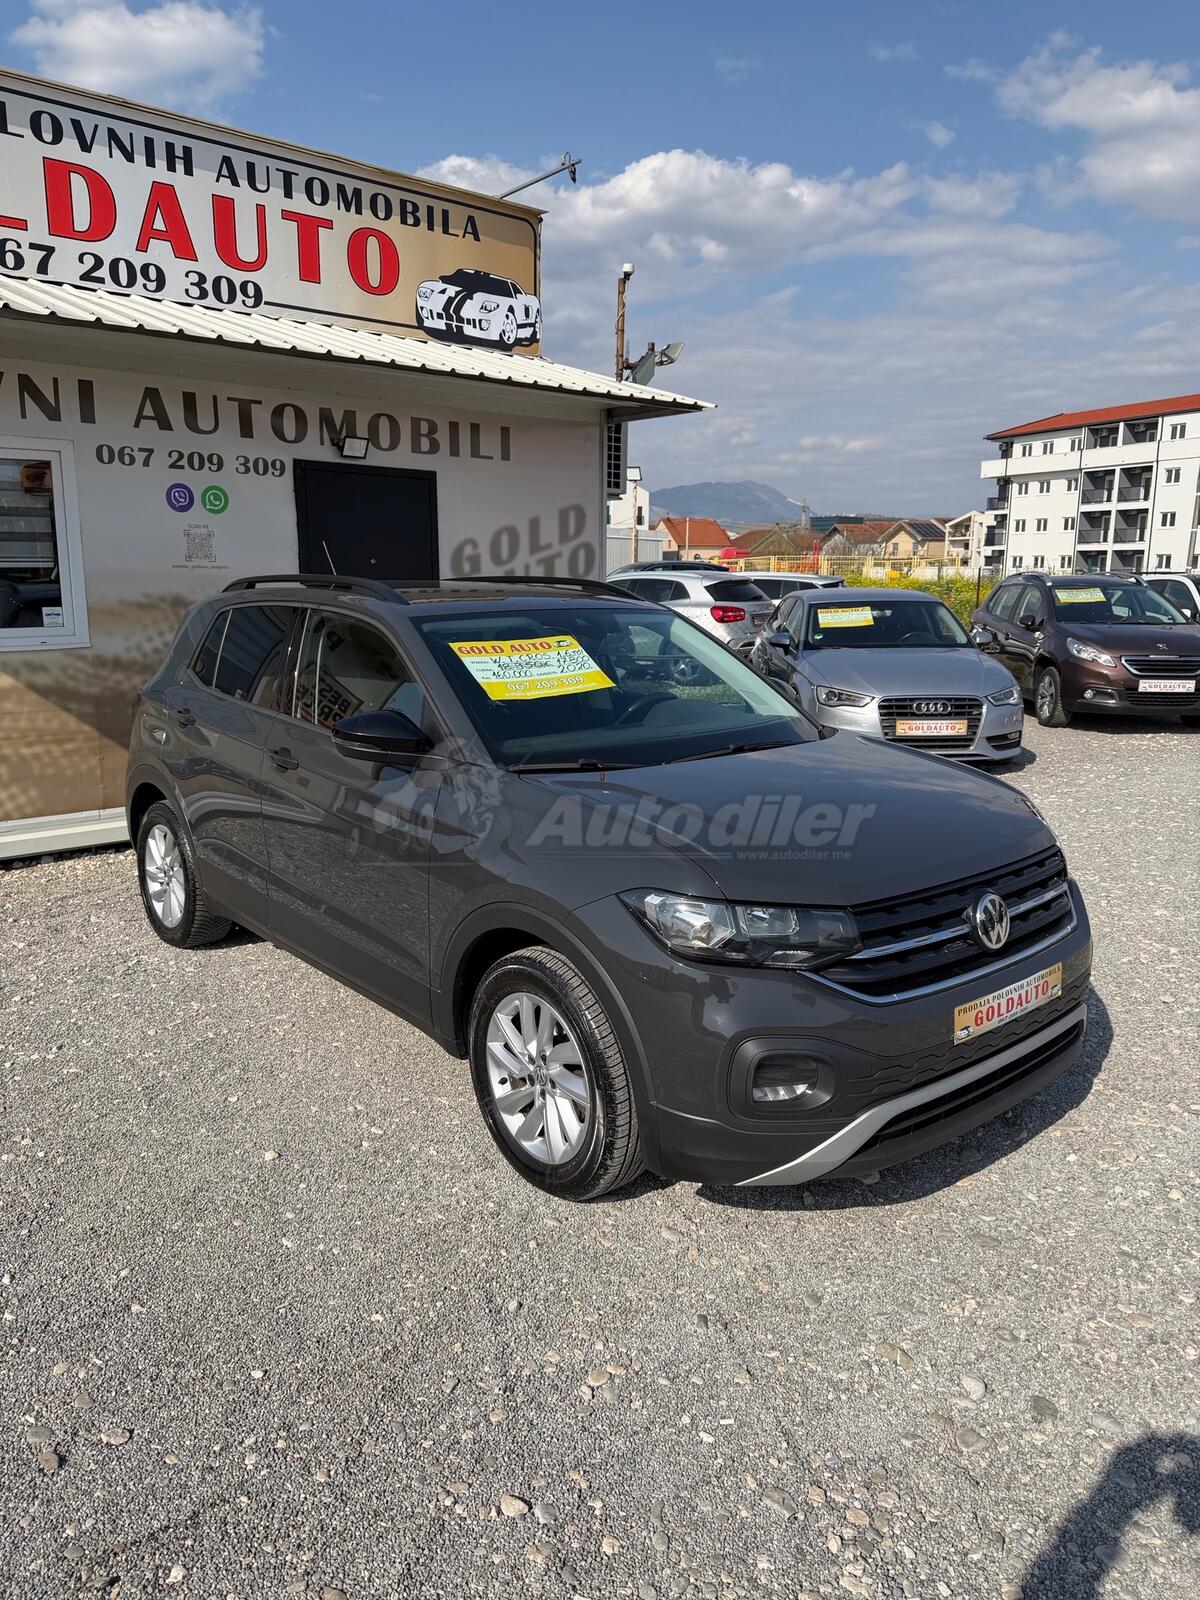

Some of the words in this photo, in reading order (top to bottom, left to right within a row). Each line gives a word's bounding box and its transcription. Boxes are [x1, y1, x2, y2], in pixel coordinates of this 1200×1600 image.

[215, 154, 482, 243] AUTOMOBILA
[0, 156, 401, 297] DAUTO
[78, 251, 168, 294] 209
[184, 270, 264, 309] 309
[0, 371, 96, 424] NI
[133, 386, 511, 461] AUTOMOBILI
[95, 444, 155, 468] 067
[168, 449, 224, 473] 209
[235, 455, 286, 477] 309
[450, 503, 587, 578] GOLD
[457, 644, 505, 655] GOLD
[510, 641, 552, 653] AUTO
[536, 679, 558, 689] 209
[908, 724, 956, 732] GOLDAUTO
[957, 997, 991, 1017] PRODAJA
[974, 980, 1050, 1027] GOLDAUTO
